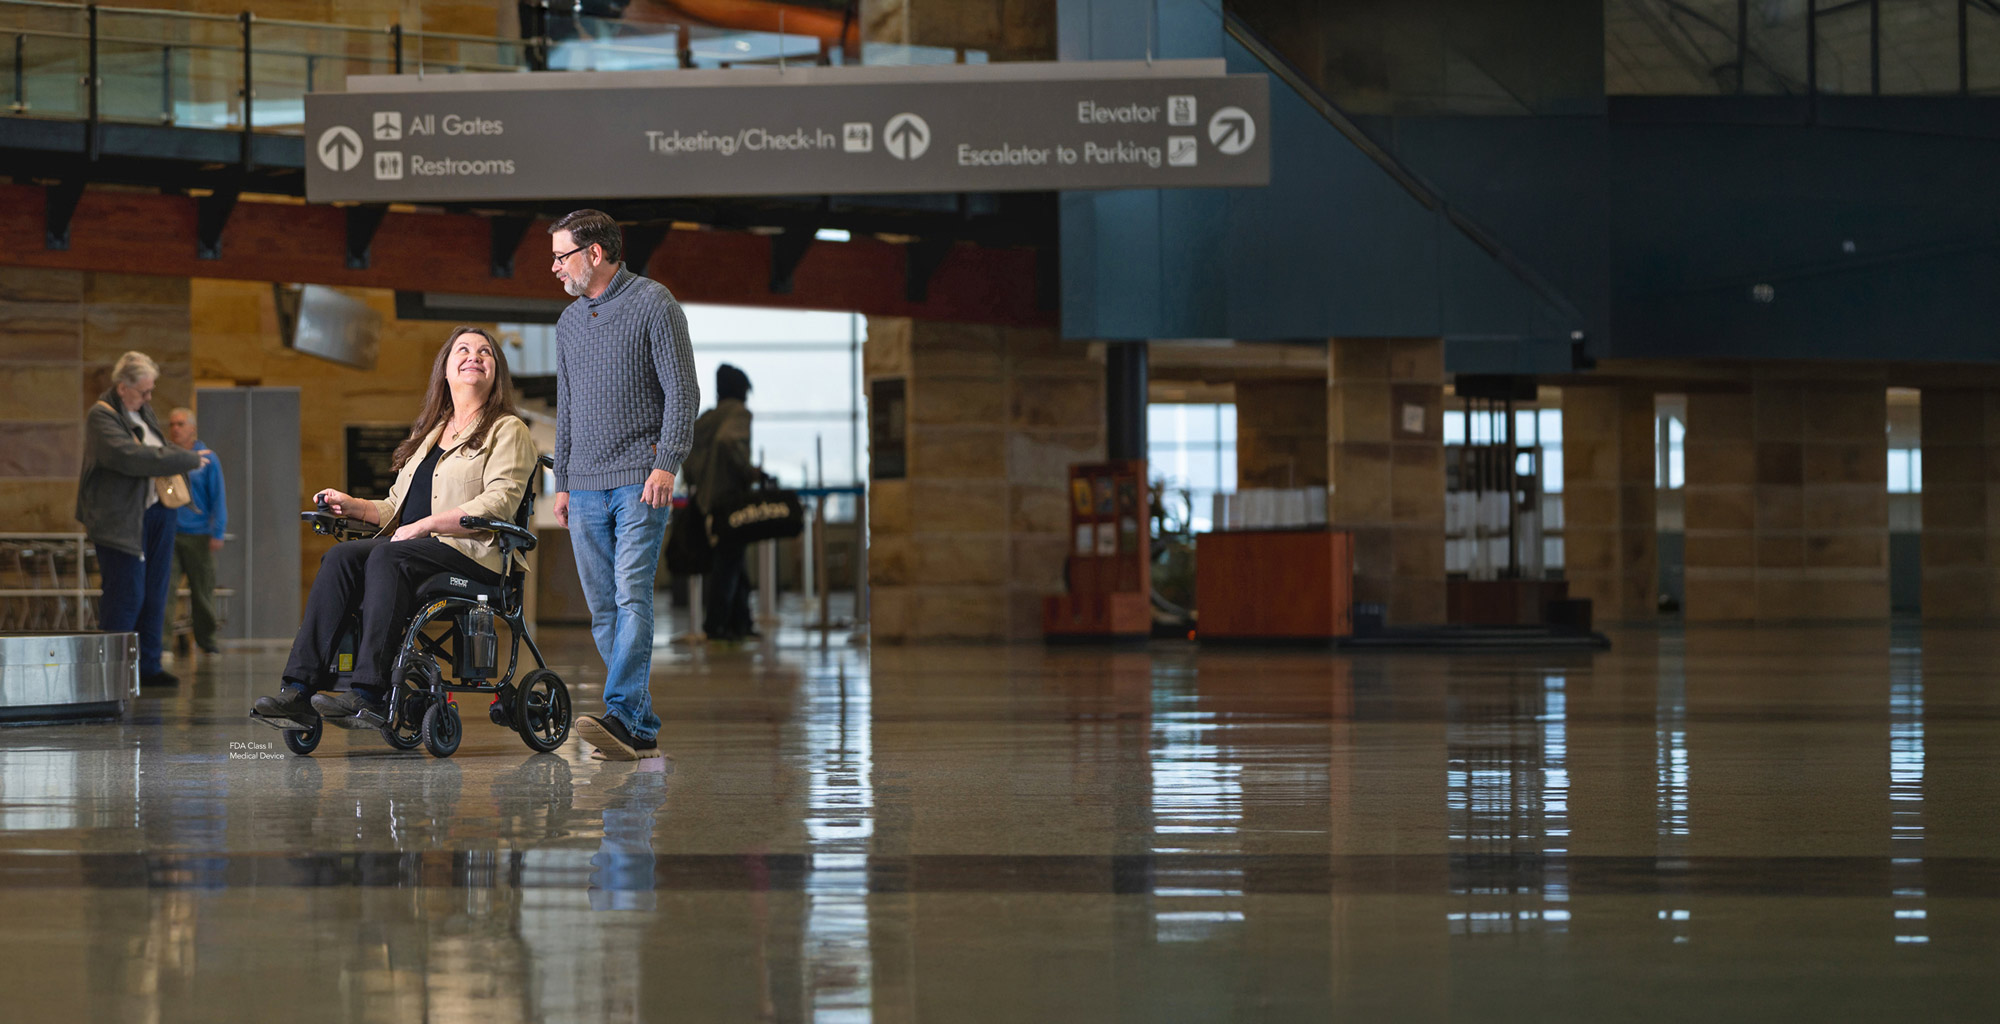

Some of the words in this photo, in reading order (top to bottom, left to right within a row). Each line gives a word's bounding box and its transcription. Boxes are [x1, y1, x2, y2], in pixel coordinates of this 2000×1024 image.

[1077, 101, 1160, 124] Elevator
[409, 115, 435, 137] All
[442, 114, 504, 136] Gates
[646, 128, 835, 155] Ticketing/Check-In
[410, 154, 516, 176] Restrooms
[957, 143, 1050, 167] Escalator
[1057, 144, 1078, 165] to
[1084, 141, 1162, 168] Parking
[729, 501, 790, 528] adidas
